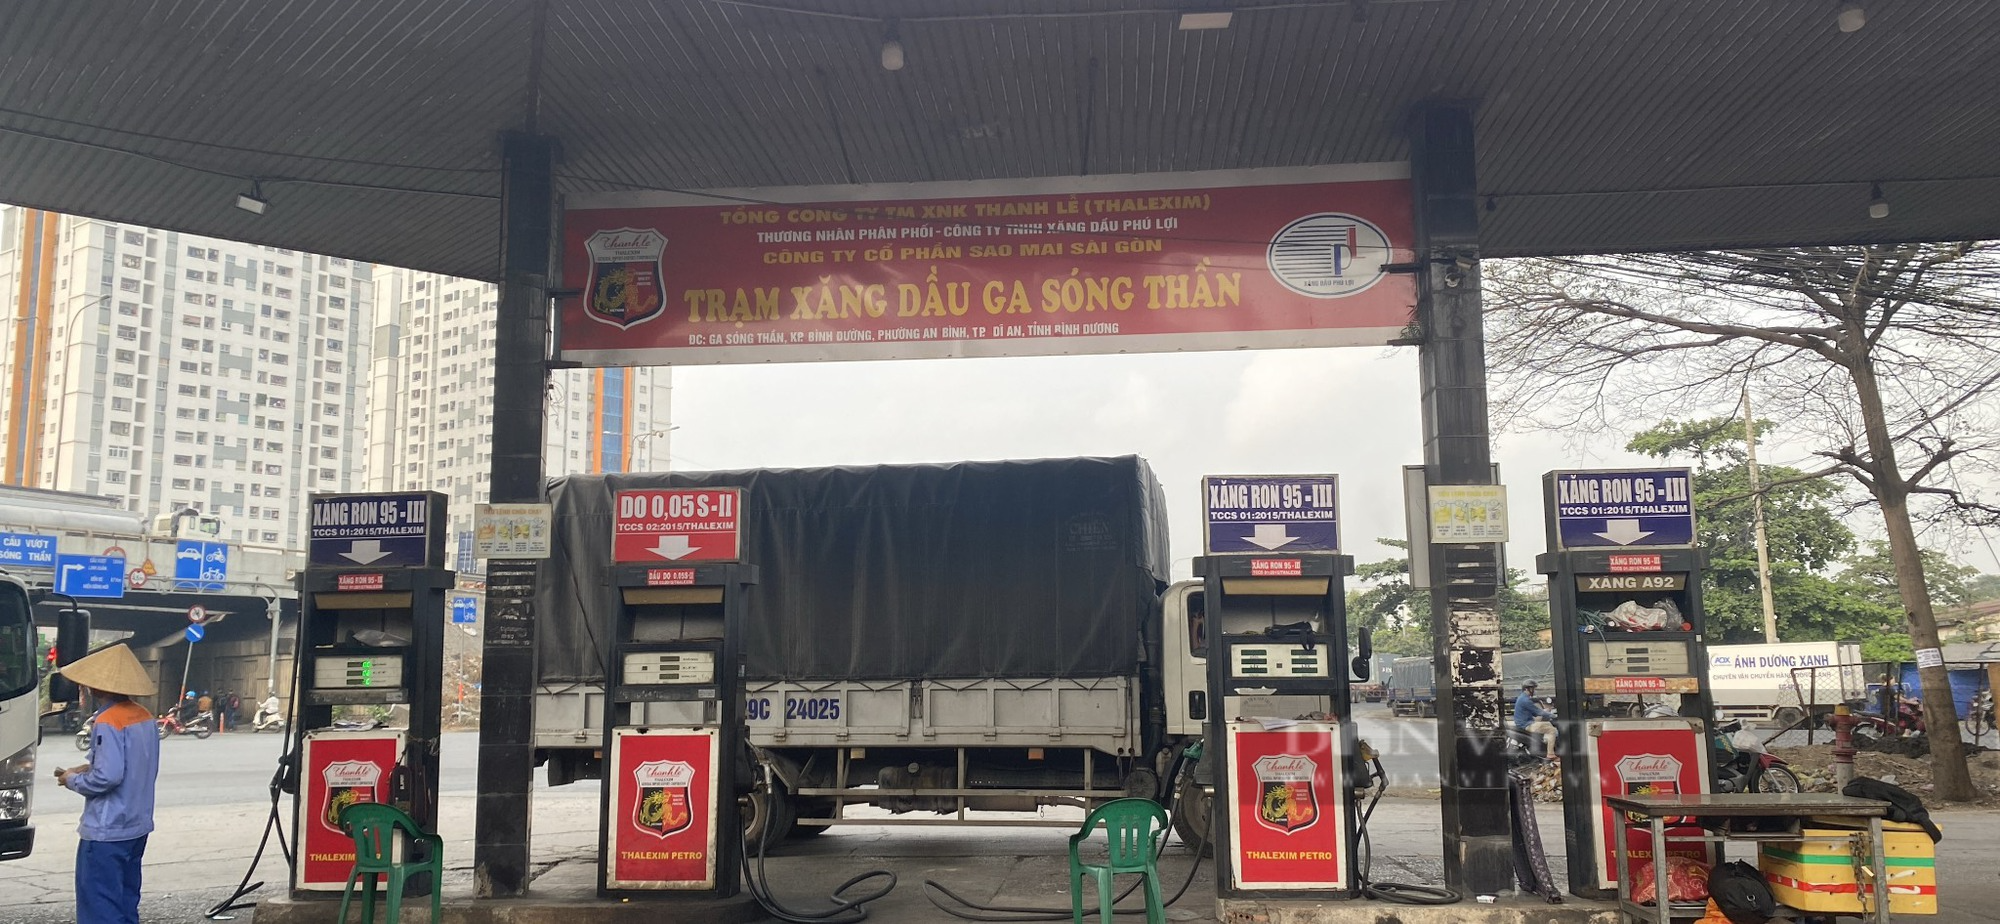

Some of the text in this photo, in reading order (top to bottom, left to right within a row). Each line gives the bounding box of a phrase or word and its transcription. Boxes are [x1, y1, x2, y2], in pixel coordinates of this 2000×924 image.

[720, 206, 780, 224] TỔNG
[885, 206, 915, 219] TM
[922, 204, 967, 218] XNK
[975, 202, 1048, 216] THANH
[1084, 193, 1210, 215] (THALEXIM)
[757, 230, 811, 243] THƯƠNG
[816, 227, 854, 241] NHÂN
[859, 227, 897, 240] PHÂN
[986, 225, 1001, 237] TY
[1007, 223, 1043, 236] TNHH
[1047, 219, 1086, 234] XĂNG
[1123, 217, 1151, 231] PHÚ
[1156, 217, 1178, 231] LỢI
[763, 247, 824, 264] CÔNG
[832, 249, 856, 262] TY
[969, 243, 1012, 258] SAO
[1020, 242, 1063, 256] MAI
[1070, 240, 1107, 255] SÀI
[1115, 236, 1162, 253] GÒN
[684, 256, 1241, 328] TRẠM XĂNG DẦU GA SÓNG THẦN
[688, 333, 705, 346] ĐC:
[709, 333, 723, 345] GA
[726, 329, 754, 344] SÓNG
[808, 328, 833, 342] BÌNH
[923, 327, 937, 339] AN
[1007, 326, 1025, 339] AN,
[1083, 321, 1119, 335] DƯƠNG
[1210, 480, 1248, 509] XĂNG
[1251, 484, 1280, 509] RON
[1282, 484, 1302, 508] 95
[1560, 474, 1599, 504] XĂNG
[1601, 479, 1632, 503] RON
[1634, 478, 1655, 503] 95
[313, 498, 348, 526] XĂNG
[351, 501, 377, 525] RON
[380, 501, 397, 524] 95
[620, 495, 646, 518] DO
[651, 494, 694, 521] 0,05
[1561, 505, 1687, 515] TCCS 01:2015/THALEXIM
[1211, 511, 1333, 520] TCCS 01:2015/THALEXIM
[339, 526, 424, 536] 01:2015/THALEXIM
[618, 521, 734, 531] TCCS 02:2015/THALEXIM
[1252, 560, 1269, 569] XĂNG
[1270, 561, 1283, 569] RON
[663, 572, 671, 580] DO
[1589, 575, 1674, 589] XĂNG A92
[1734, 654, 1756, 669] ÁNH
[1760, 654, 1796, 668] DƯƠNG
[1799, 654, 1829, 667] XANH
[746, 698, 840, 720] 9C 24025
[310, 853, 355, 861] THALEXIM
[621, 852, 702, 860] THALEXIM PETRO
[1246, 851, 1332, 860] THALEXIM PETRO
